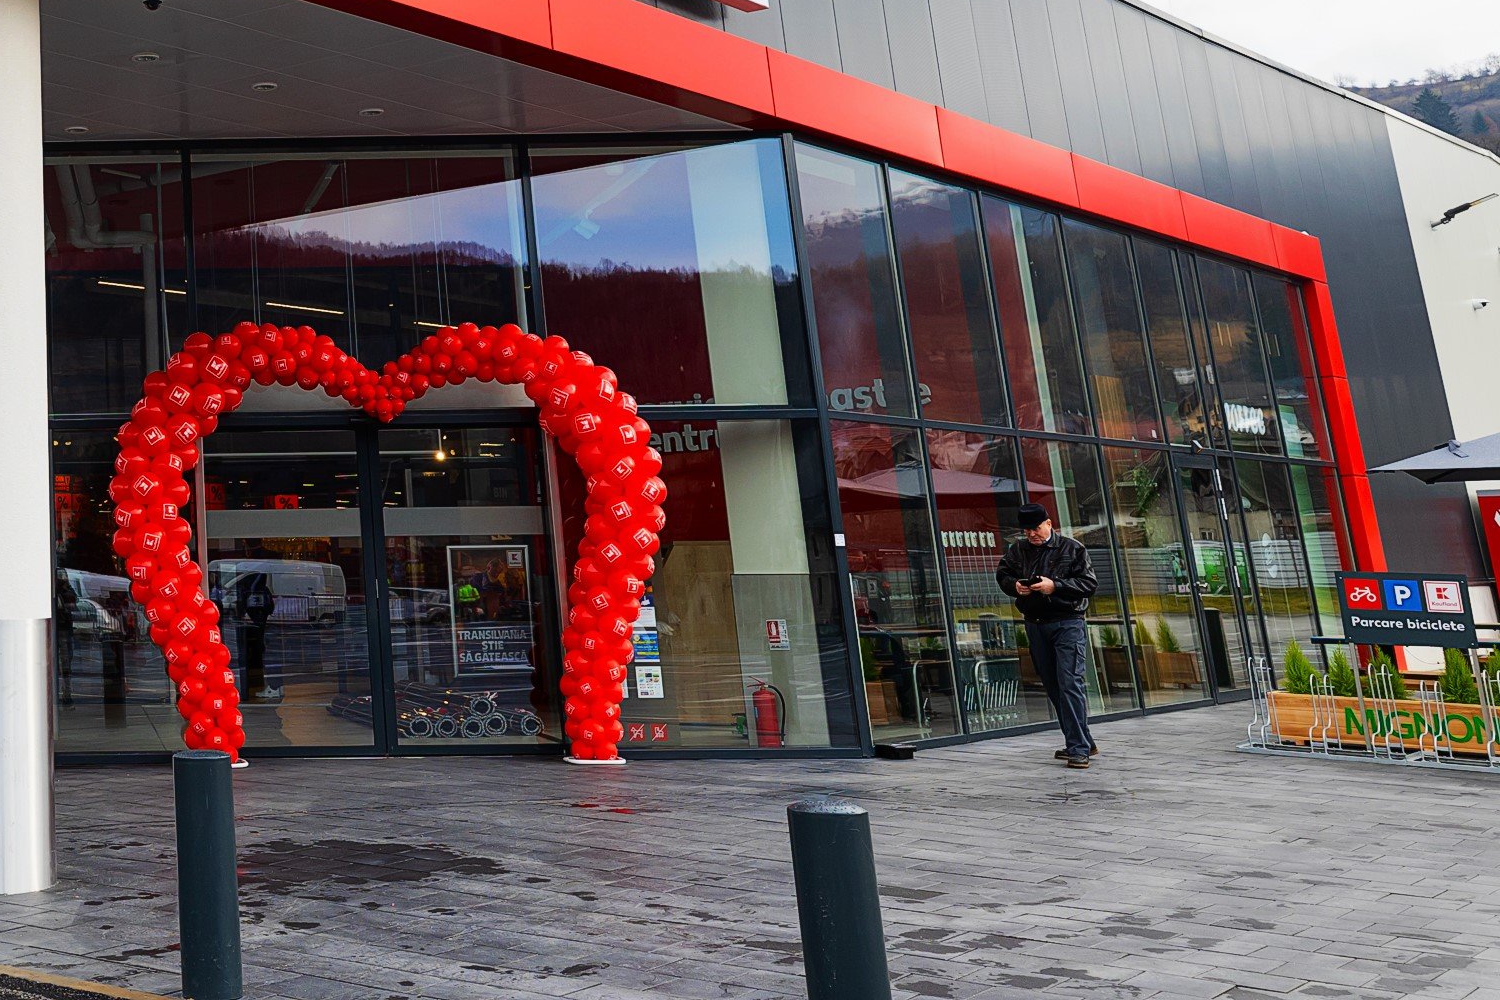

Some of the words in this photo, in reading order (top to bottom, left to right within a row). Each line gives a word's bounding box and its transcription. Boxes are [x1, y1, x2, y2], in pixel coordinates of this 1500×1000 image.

[1394, 585, 1411, 605] P
[1351, 616, 1403, 628] Parcare
[1407, 618, 1465, 631] biciclete
[457, 629, 527, 640] TRANSILVANIA
